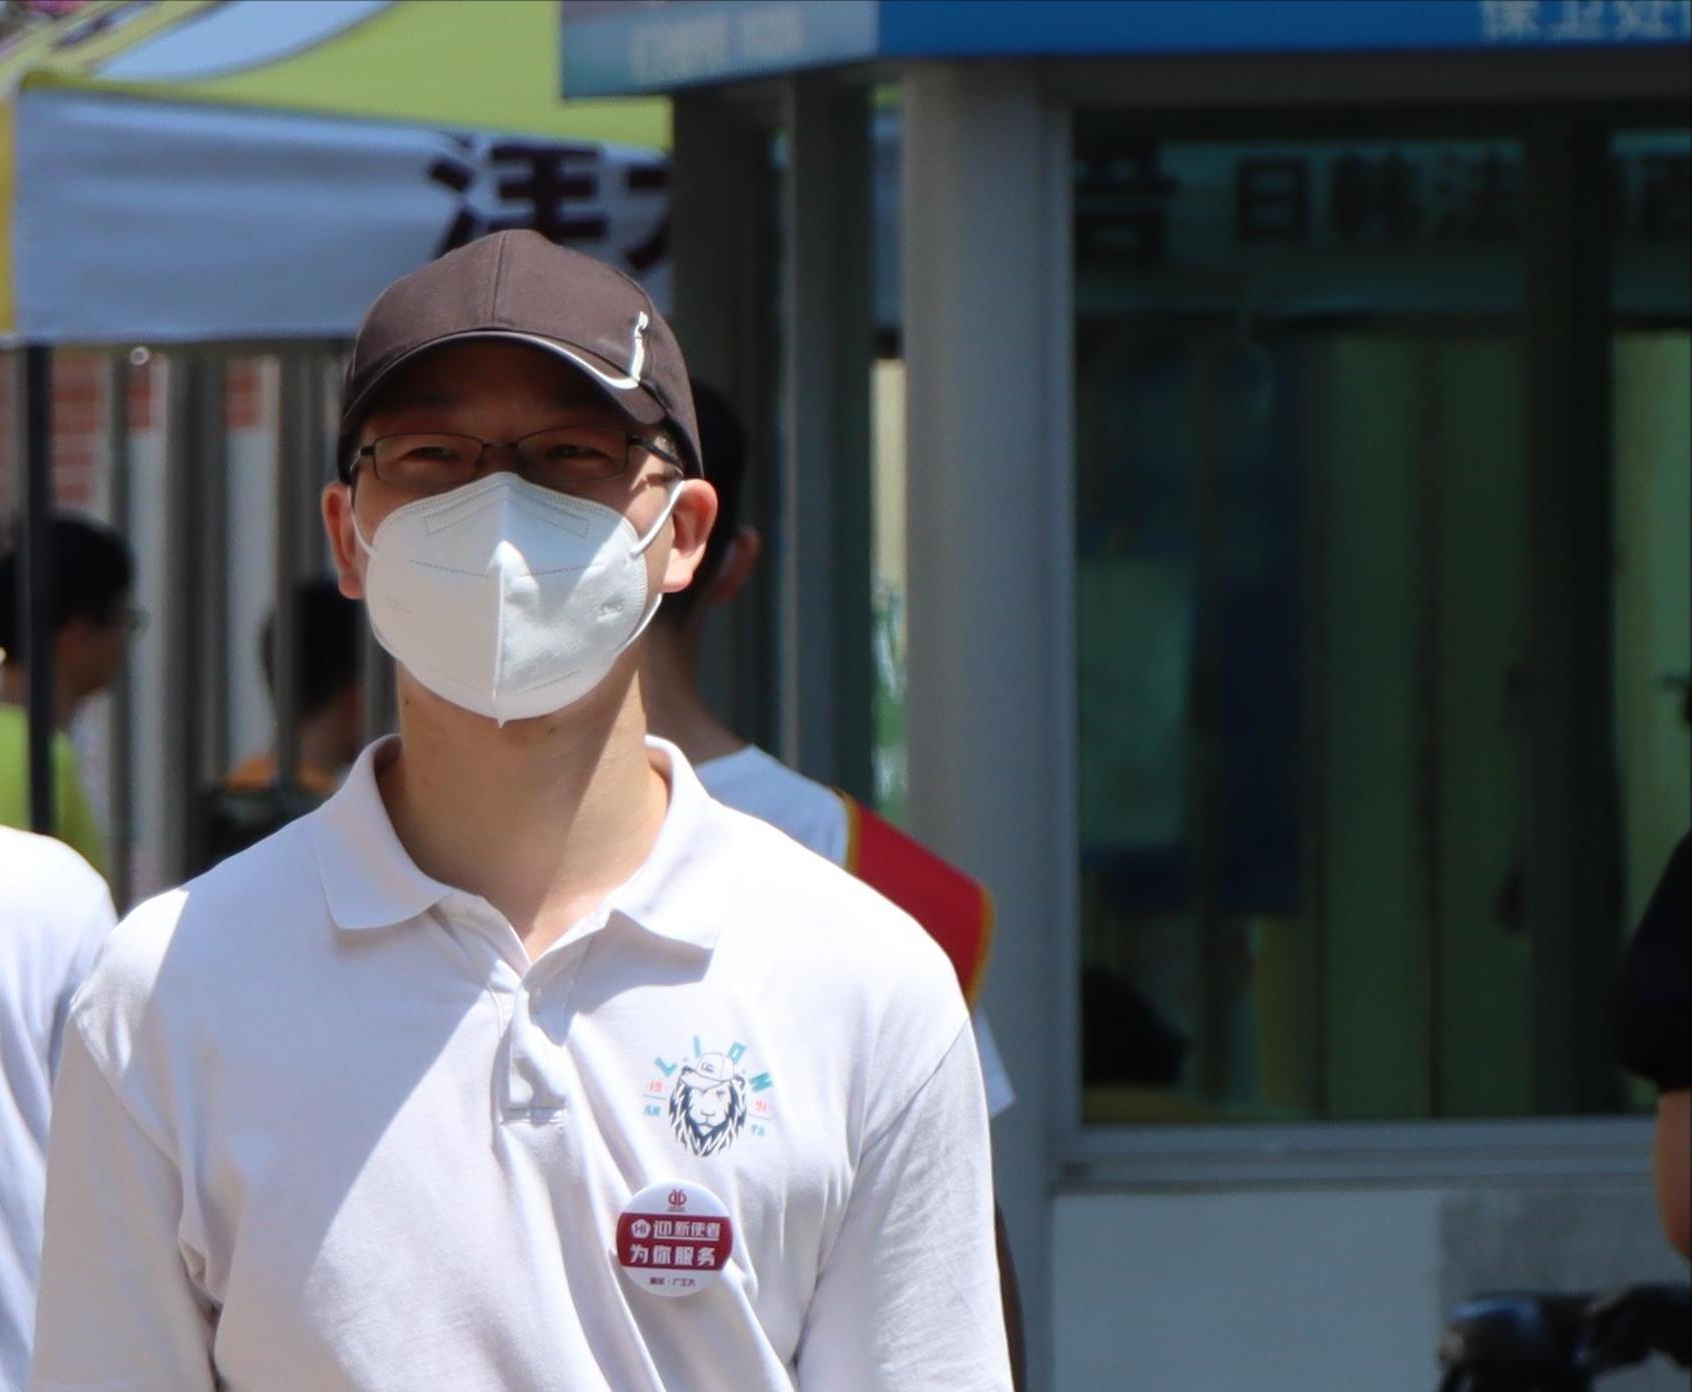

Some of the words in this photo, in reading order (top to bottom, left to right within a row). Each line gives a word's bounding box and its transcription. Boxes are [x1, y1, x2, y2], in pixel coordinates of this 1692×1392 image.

[653, 1035, 773, 1093] LION
[653, 1220, 722, 1241] 迎新使者
